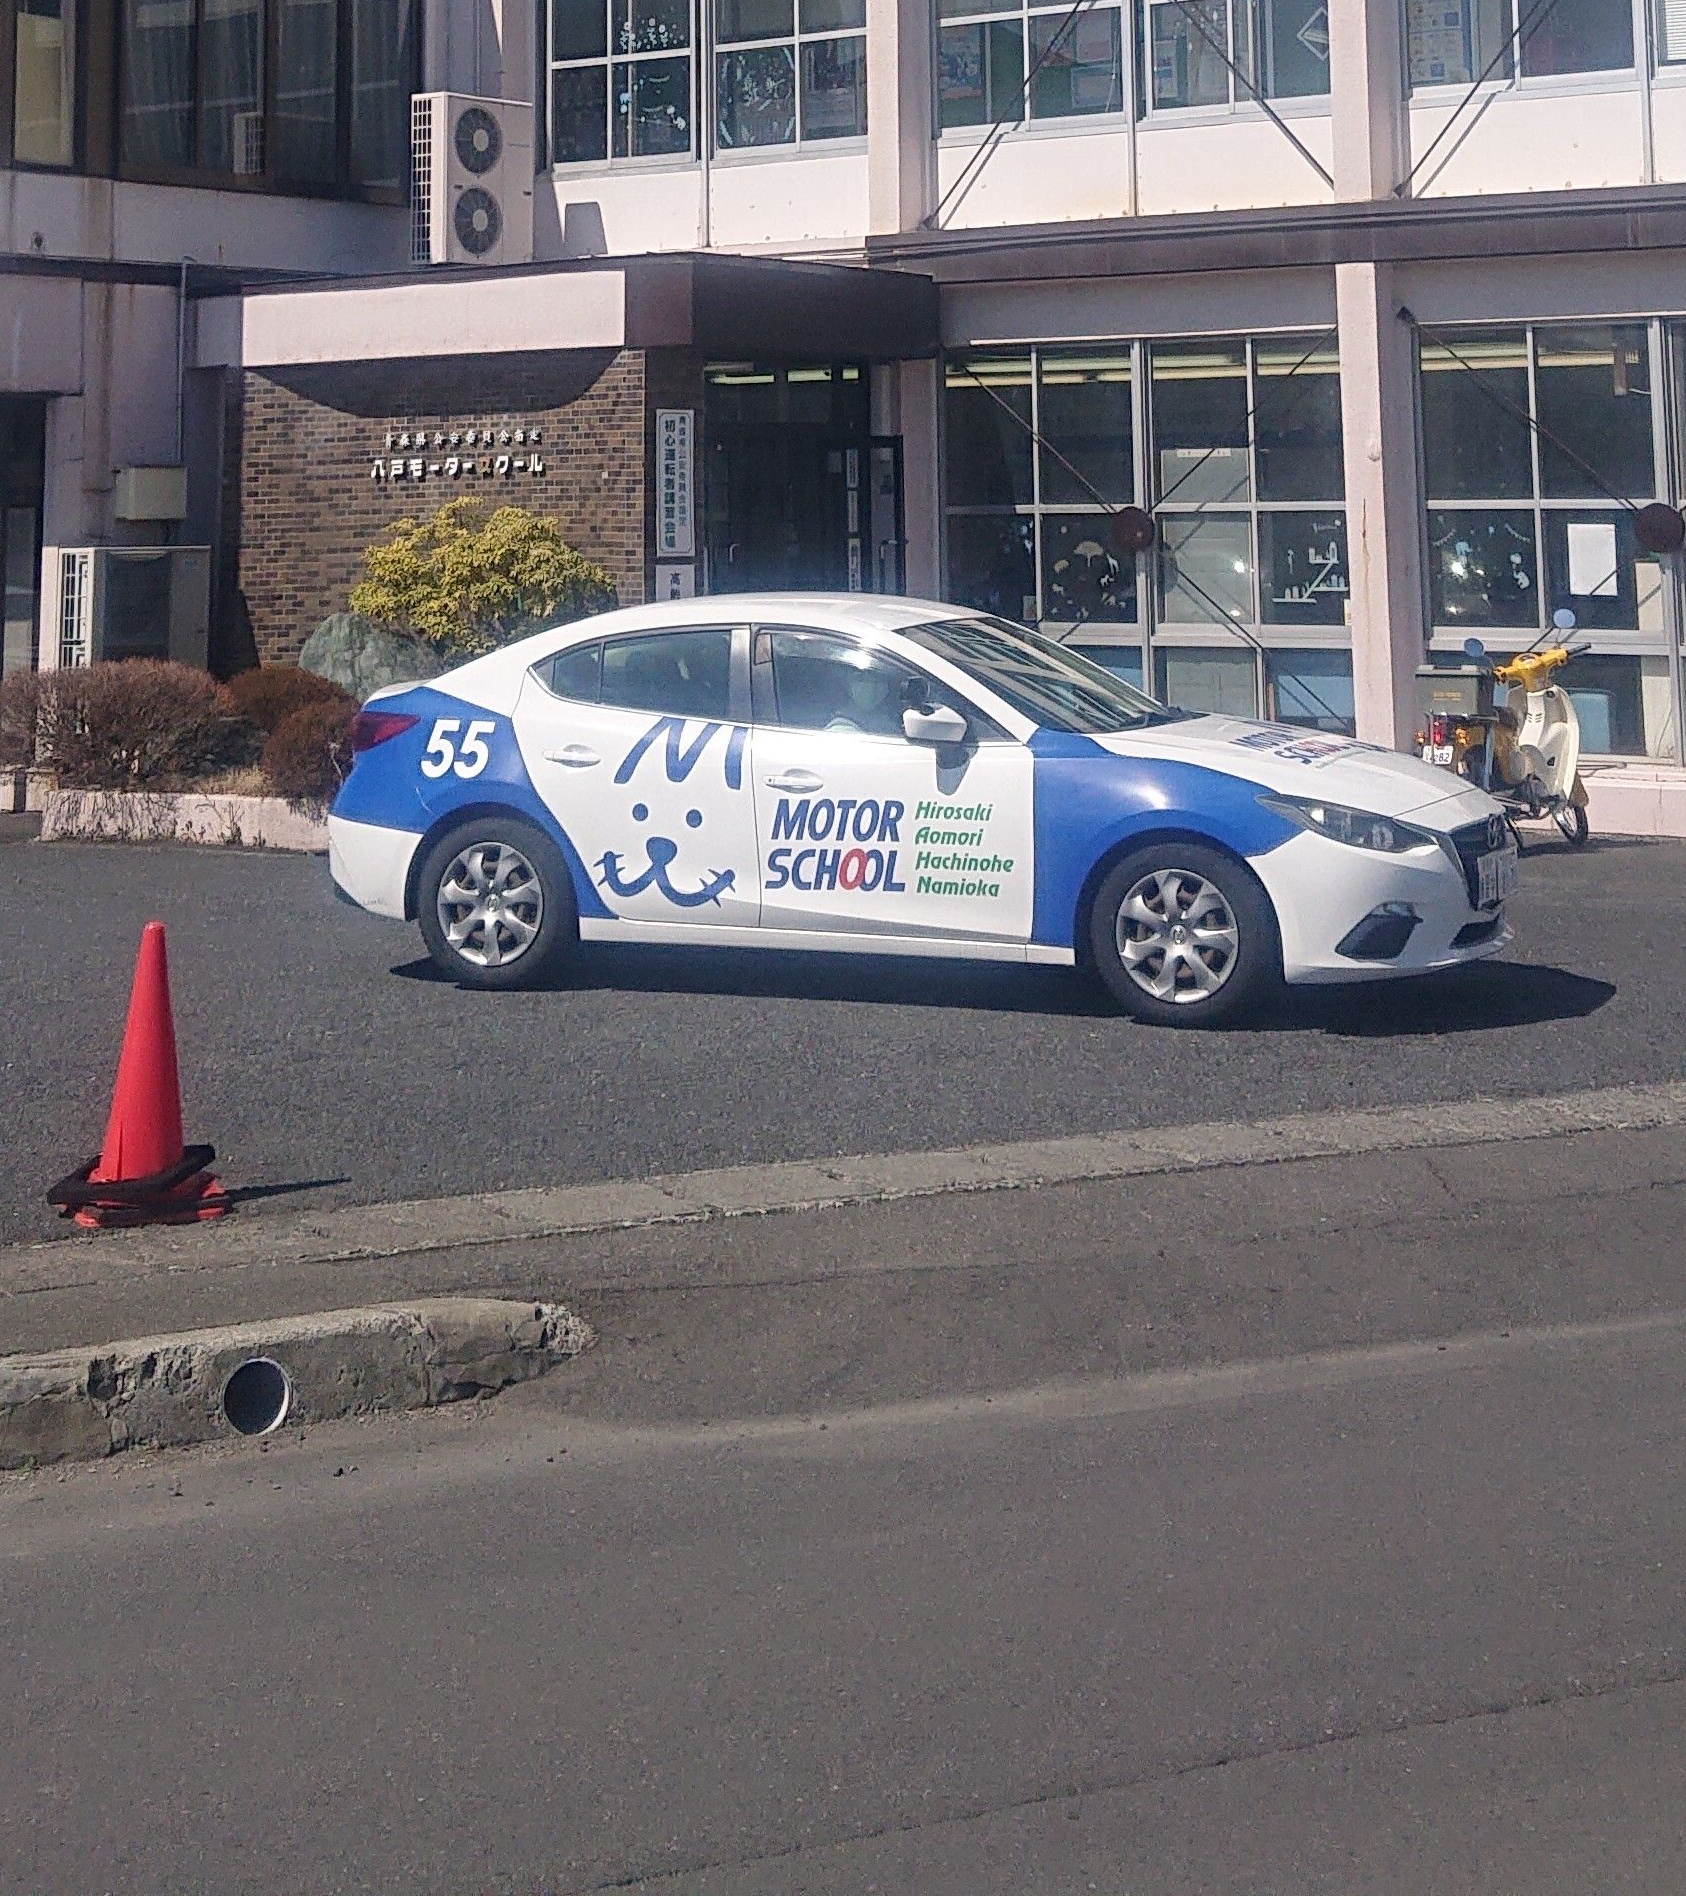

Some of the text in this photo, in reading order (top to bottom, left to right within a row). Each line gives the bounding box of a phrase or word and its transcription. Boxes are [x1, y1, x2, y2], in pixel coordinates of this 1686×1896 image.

[371, 454, 543, 479] 八戸モータースクール
[420, 719, 495, 779] 55
[771, 798, 905, 842] MOTOR
[914, 801, 994, 821] Hirosaki
[914, 826, 984, 846] Aomori
[765, 848, 906, 892] SCHOOL
[915, 851, 1015, 873] Hachinohe
[916, 876, 1001, 897] Namioka
